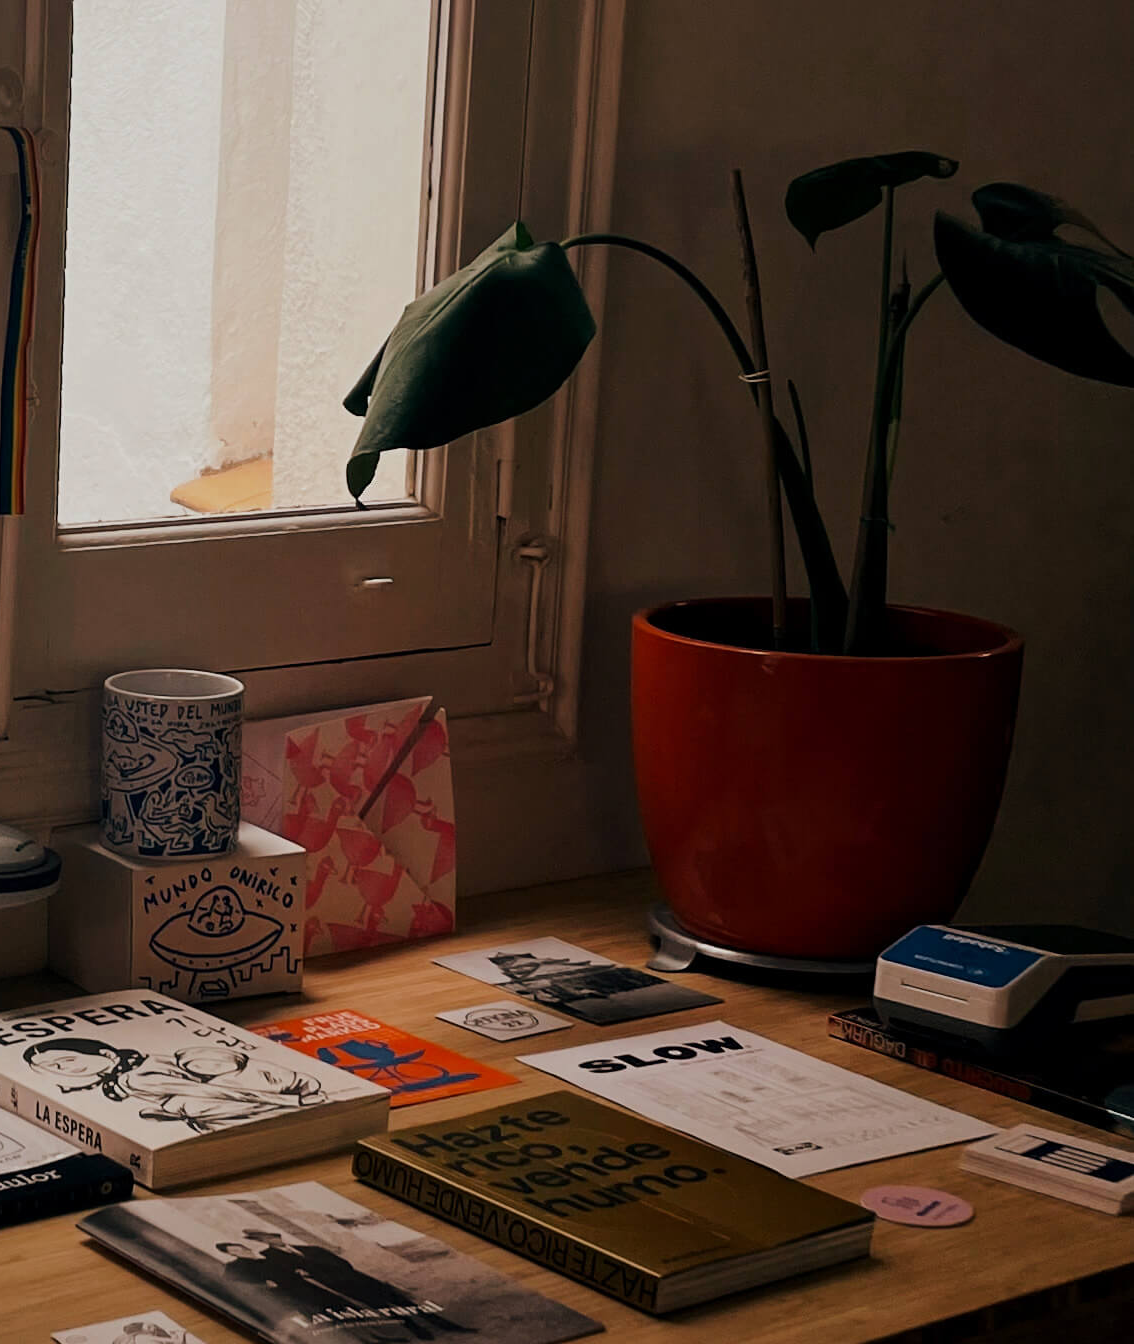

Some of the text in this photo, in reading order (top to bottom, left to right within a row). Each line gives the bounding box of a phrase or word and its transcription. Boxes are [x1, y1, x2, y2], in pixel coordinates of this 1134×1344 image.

[124, 699, 168, 718] USTED
[178, 704, 202, 719] DEL
[143, 868, 212, 913] MUNDO
[579, 1036, 746, 1074] SLOW
[35, 1099, 103, 1152] LA ESPERA
[390, 1109, 570, 1157] Hazte
[354, 1150, 423, 1201] HUMO
[444, 1142, 588, 1177] rico,
[490, 1141, 671, 1195] vende
[425, 1178, 501, 1239] VENDE
[522, 1163, 727, 1218] humo.
[569, 1245, 659, 1309] HAZTE
